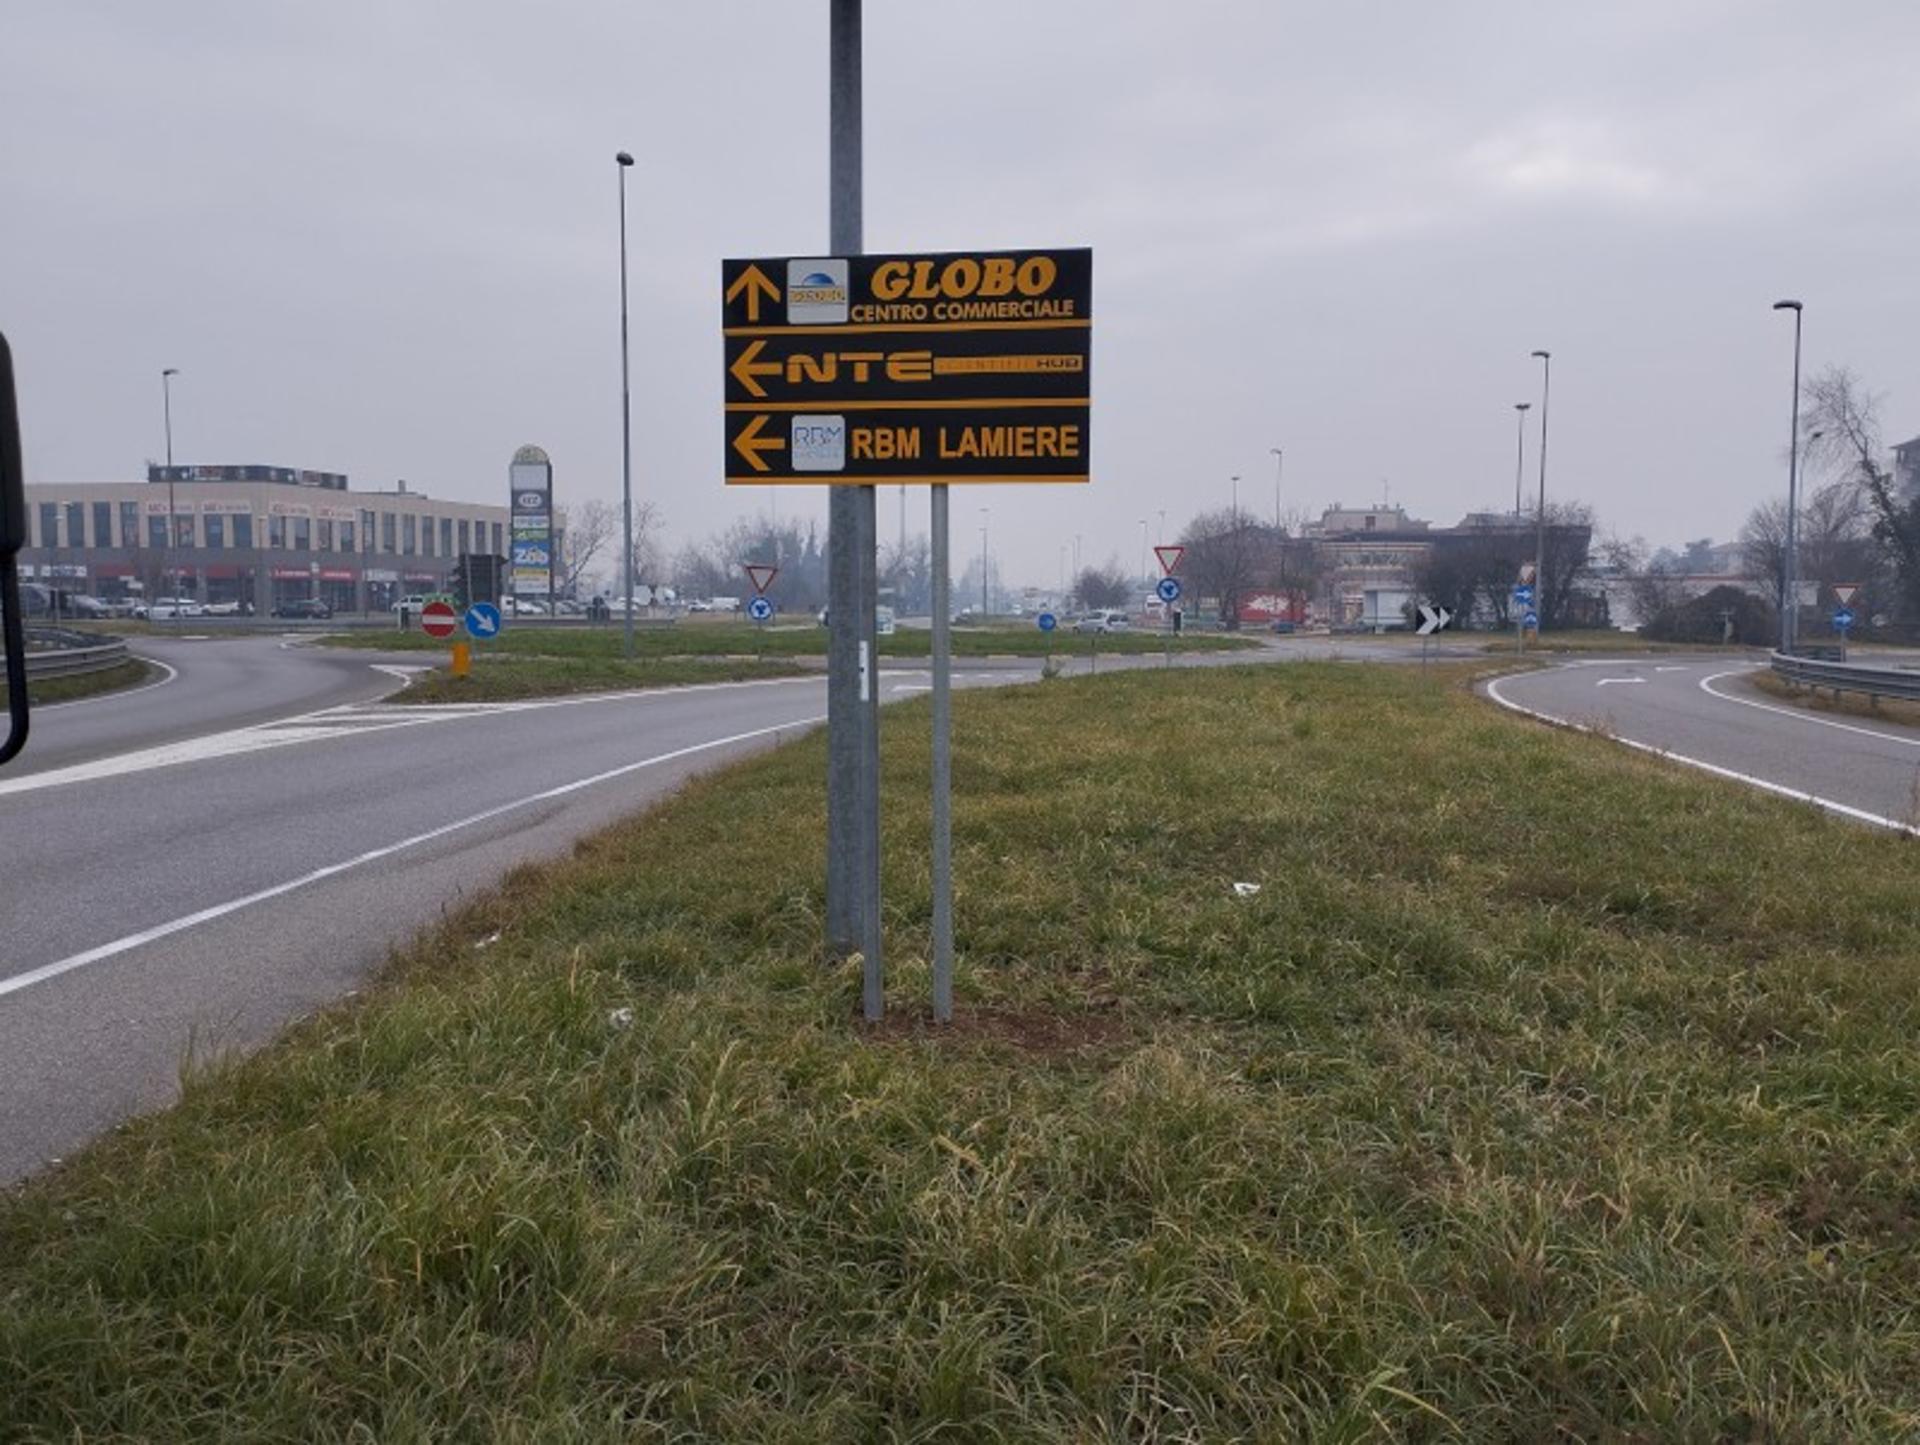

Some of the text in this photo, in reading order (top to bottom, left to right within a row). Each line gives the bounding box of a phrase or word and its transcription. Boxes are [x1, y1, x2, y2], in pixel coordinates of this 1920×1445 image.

[871, 256, 1057, 300] GLOBO
[851, 299, 1075, 323] CENTRO COMMERCIALE
[786, 351, 932, 383] NTE
[1037, 357, 1079, 369] HUB
[852, 425, 1079, 460] RBM LAMIERE
